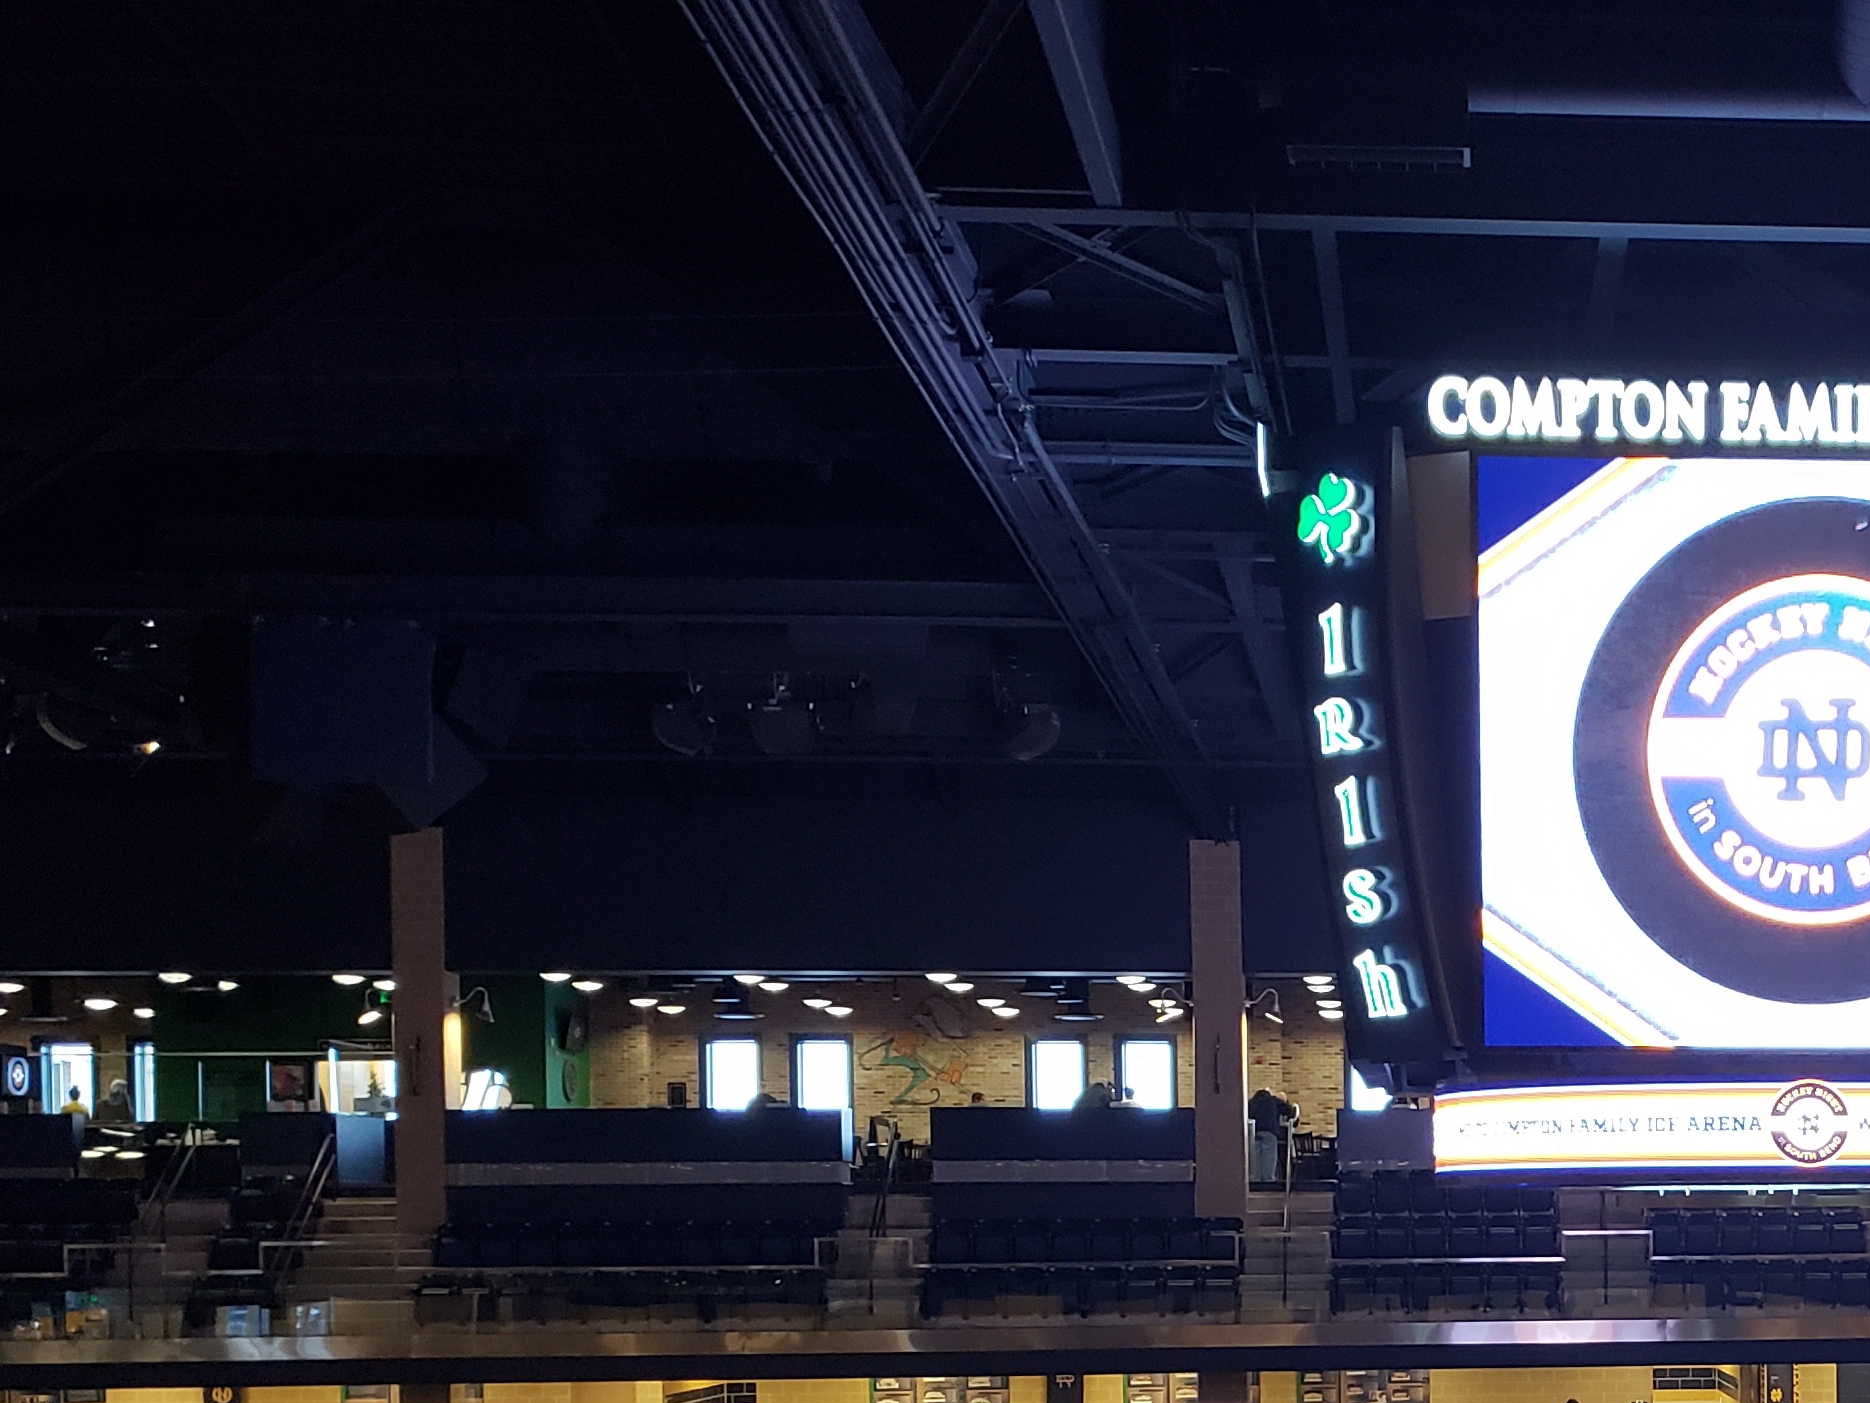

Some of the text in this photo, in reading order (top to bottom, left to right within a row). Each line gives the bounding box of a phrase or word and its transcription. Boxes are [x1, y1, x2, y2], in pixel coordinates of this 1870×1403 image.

[1428, 374, 1710, 442] COMPTON
[1687, 602, 1831, 706] HOCKEY
[1687, 797, 1718, 835] in
[1713, 829, 1836, 896] SOUTH
[1570, 1116, 1640, 1134] FAMILY
[1647, 1116, 1677, 1133] ICE
[1686, 1115, 1762, 1132] ARENA
